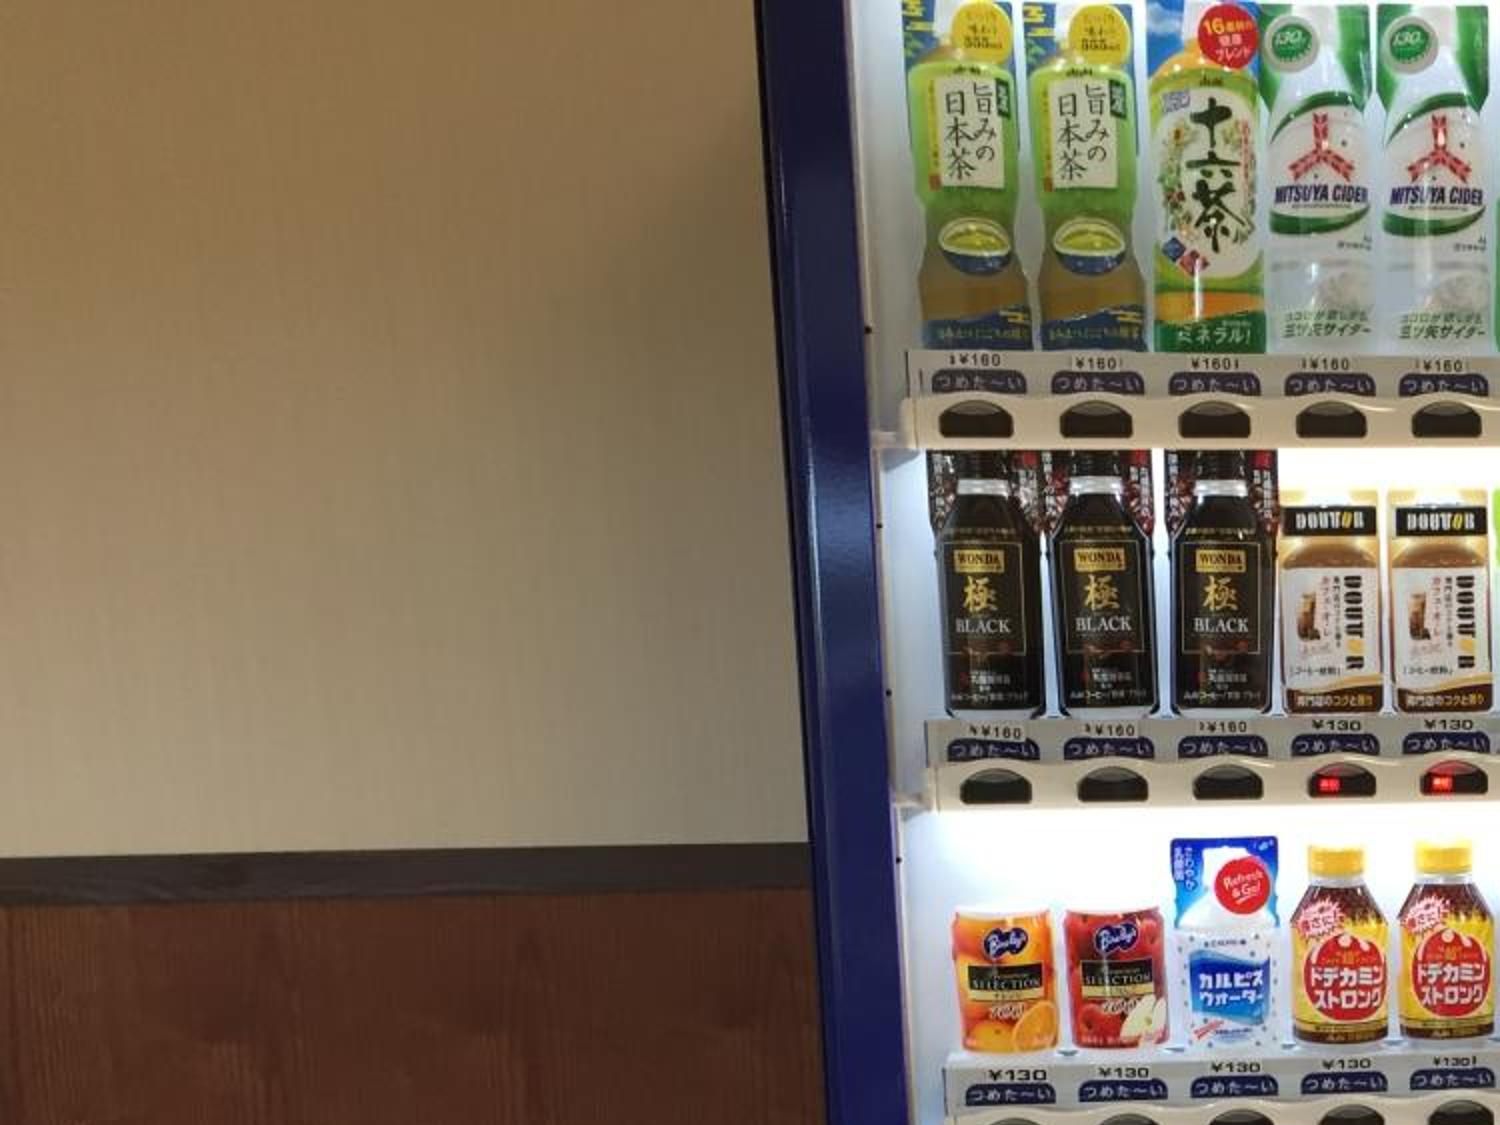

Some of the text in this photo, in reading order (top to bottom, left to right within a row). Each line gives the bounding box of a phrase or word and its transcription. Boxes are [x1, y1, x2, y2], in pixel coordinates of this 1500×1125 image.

[973, 82, 997, 162] 旨みの
[1084, 84, 1110, 162] 旨みの
[944, 90, 977, 181] 日本茶
[1057, 92, 1088, 182] 日本茶
[1186, 97, 1246, 253] 十六茶
[959, 353, 1001, 367] ¥160
[1075, 357, 1117, 370] ¥160
[1191, 357, 1232, 370] ¥160
[1311, 358, 1350, 371] ¥160
[1423, 359, 1464, 372] ¥160
[1295, 511, 1365, 530] DOUTOR
[1406, 511, 1475, 531] DOUTOR
[957, 552, 1001, 566] WONDA
[1077, 552, 1123, 564] WONDA
[1199, 553, 1243, 566] WONDA
[962, 575, 998, 613] 極
[1083, 575, 1121, 611] 極
[1202, 575, 1239, 611] 極
[955, 618, 1012, 634] BLACK
[1075, 616, 1132, 633] BLACK
[1193, 617, 1250, 633] BLACK
[981, 725, 1022, 739] ¥160
[1094, 724, 1136, 737] ¥160
[1207, 721, 1248, 733] ¥160
[1312, 719, 1362, 731] ¥130
[1424, 719, 1474, 731] ¥130
[1198, 971, 1264, 989] カルピス
[1310, 963, 1384, 988] ドデカミン
[1417, 963, 1486, 985] ドデカミン
[1199, 990, 1264, 1007] ウォーター
[1314, 988, 1382, 1009] ストロング
[1420, 985, 1484, 1007] ストロング
[1210, 1061, 1261, 1073] ¥130
[1322, 1057, 1372, 1069] ¥130
[1433, 1056, 1471, 1067] ¥130
[988, 1069, 1047, 1081] ¥130
[1098, 1066, 1150, 1078] ¥130
